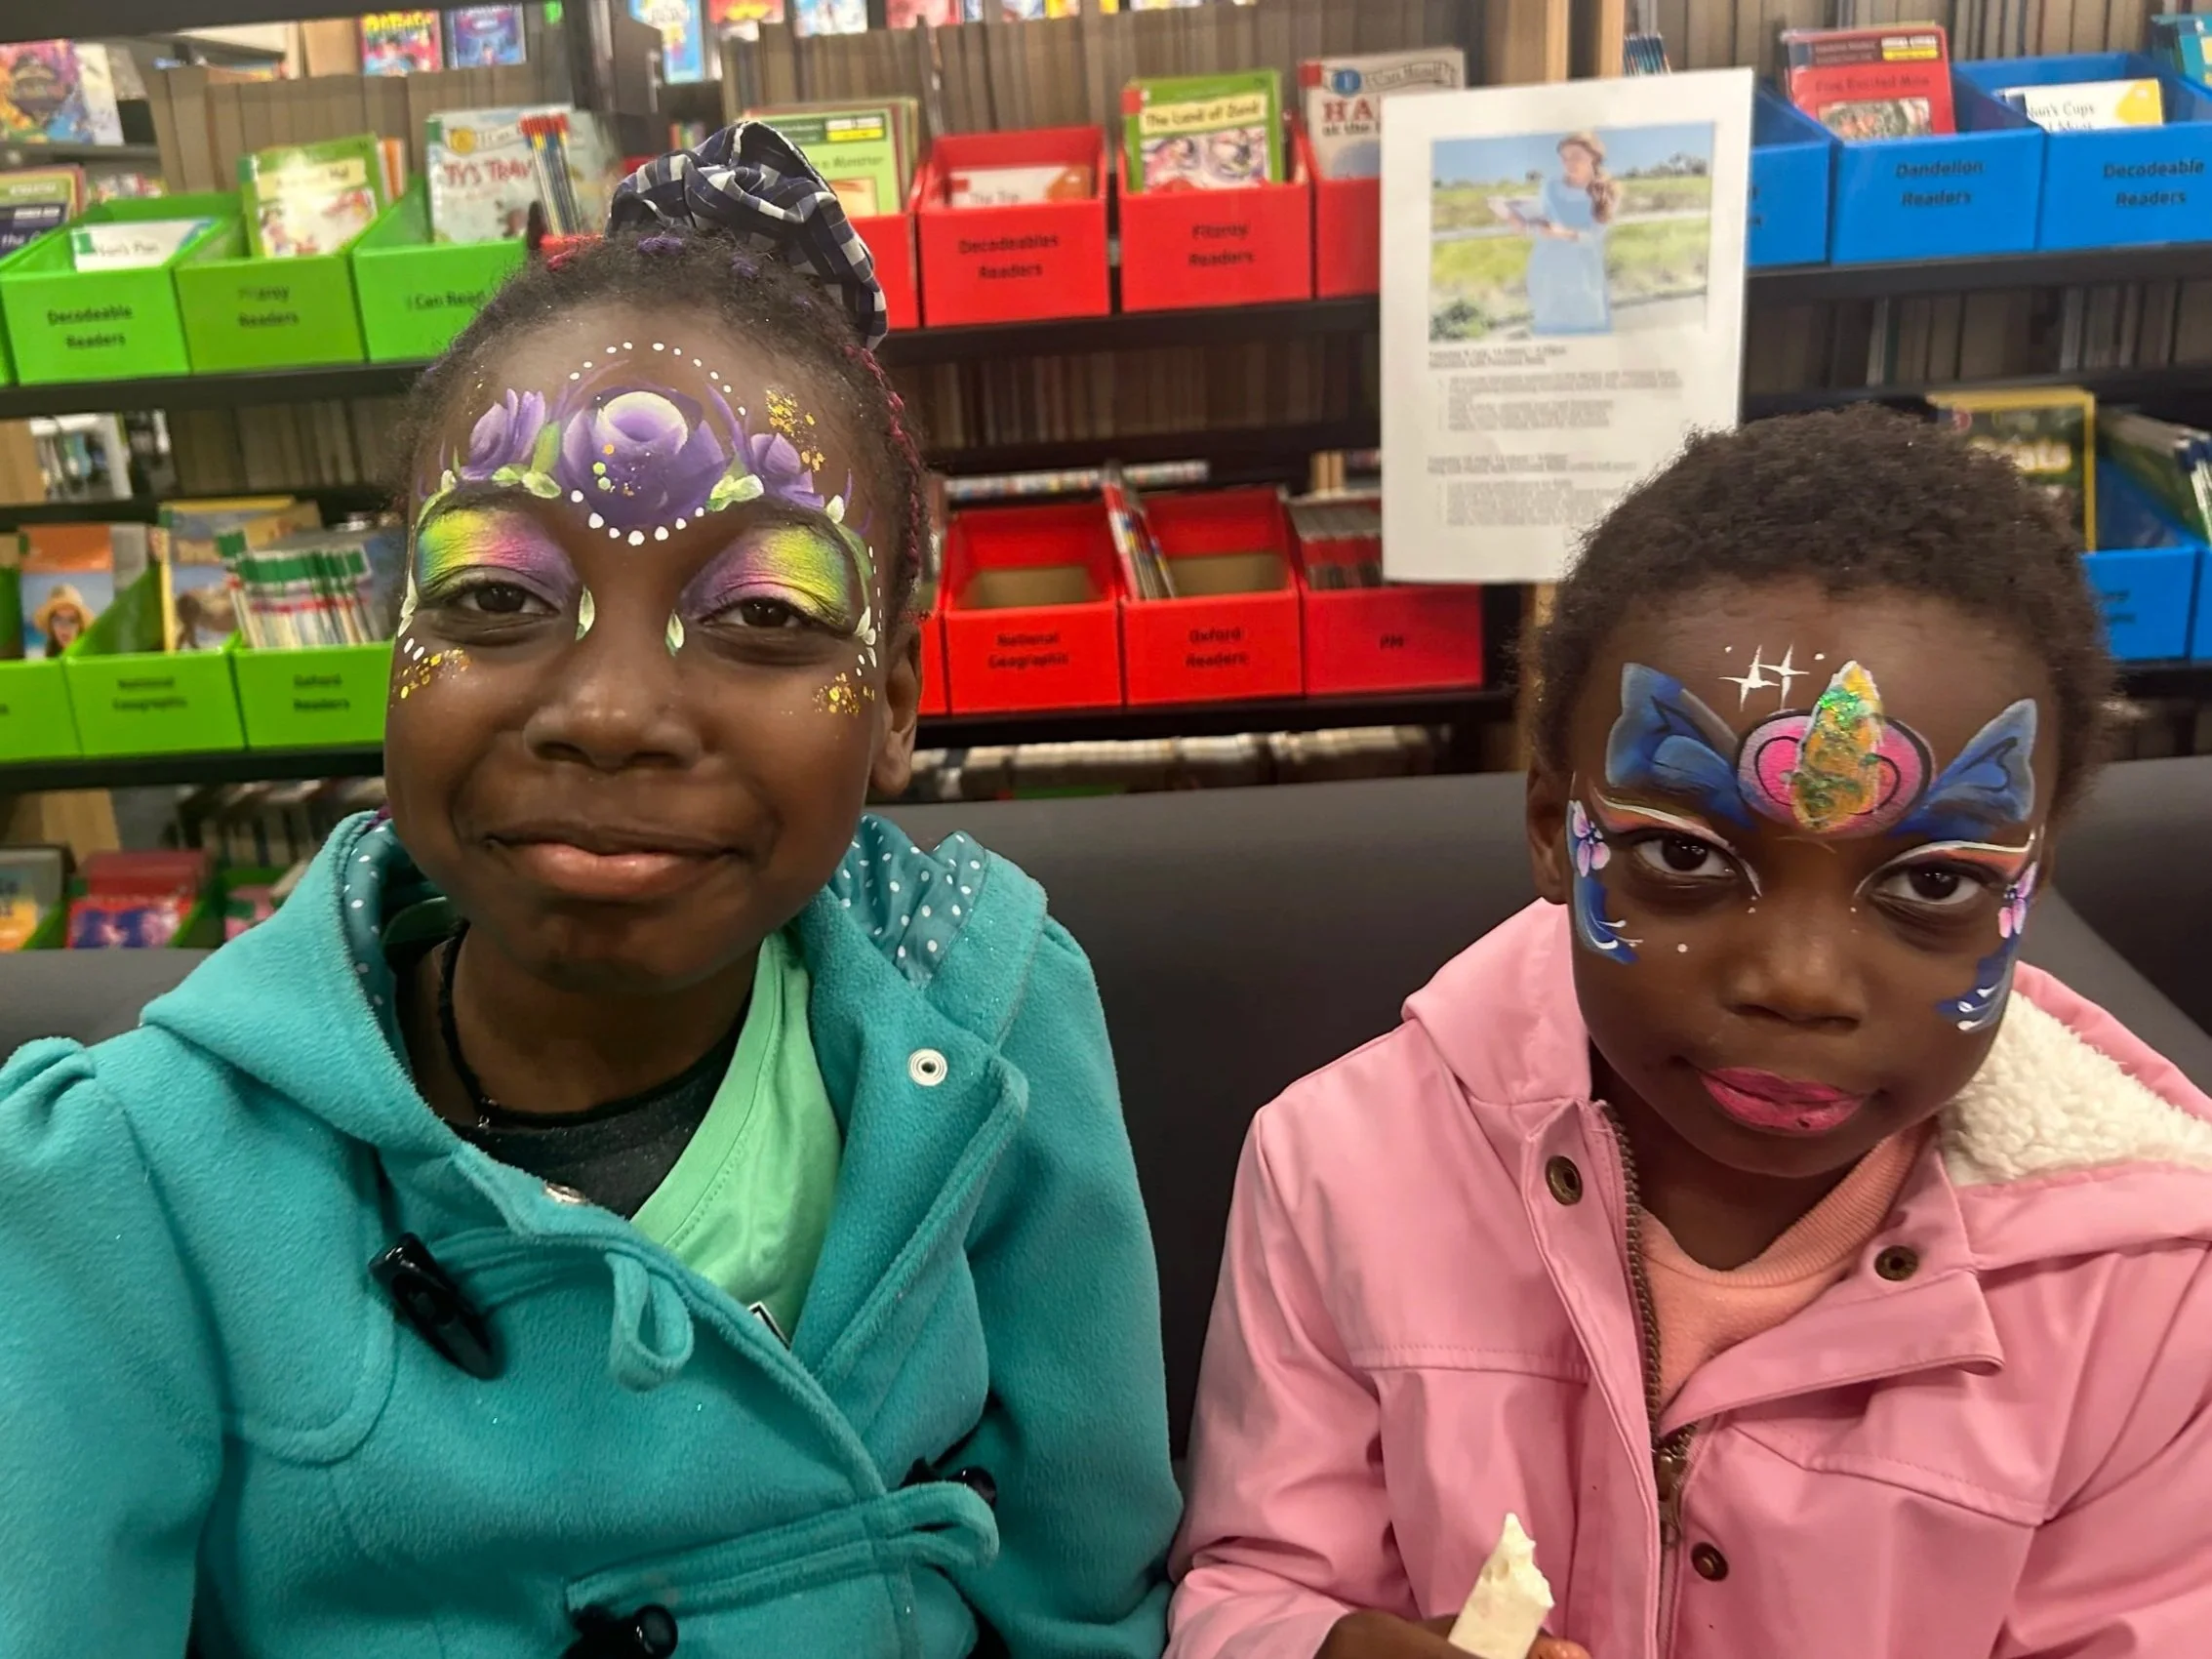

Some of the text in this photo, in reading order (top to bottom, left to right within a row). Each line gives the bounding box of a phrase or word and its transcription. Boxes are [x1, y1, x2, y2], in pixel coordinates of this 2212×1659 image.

[1146, 112, 1169, 127] The
[1171, 107, 1204, 126] Land
[1207, 105, 1224, 121] of
[1896, 158, 1985, 180] Dandelion
[2102, 158, 2205, 180] Decodeable
[1901, 188, 1972, 208] Readers
[2114, 190, 2187, 208] Readers
[1191, 222, 1250, 241] Fitzroy
[957, 234, 1061, 256] Decodeables
[1187, 250, 1257, 267] Readers
[978, 263, 1044, 280] Readers
[237, 286, 290, 304] Fzroy
[414, 292, 446, 310] Can
[47, 303, 134, 326] Decodeable
[236, 309, 301, 328] Readers
[65, 332, 127, 349] Readers
[1185, 652, 1250, 669] Readers
